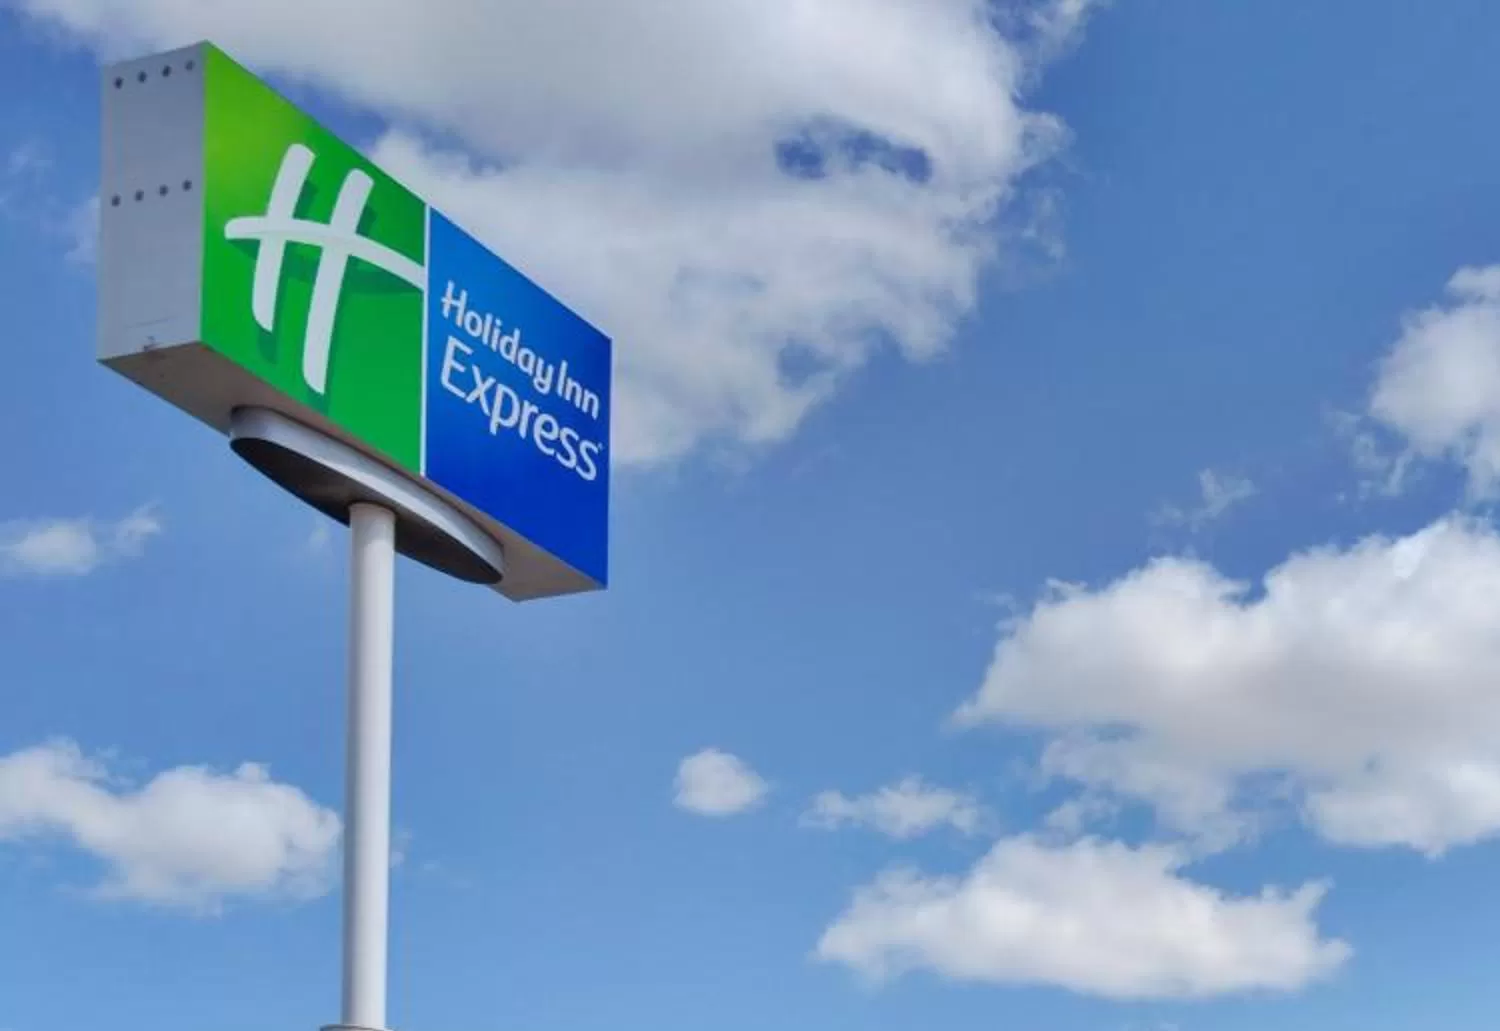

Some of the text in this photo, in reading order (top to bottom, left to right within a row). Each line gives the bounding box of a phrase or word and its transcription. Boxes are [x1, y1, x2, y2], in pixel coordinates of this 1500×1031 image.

[224, 142, 425, 395] H
[440, 279, 600, 420] Holiday Inn
[440, 335, 598, 481] Express
